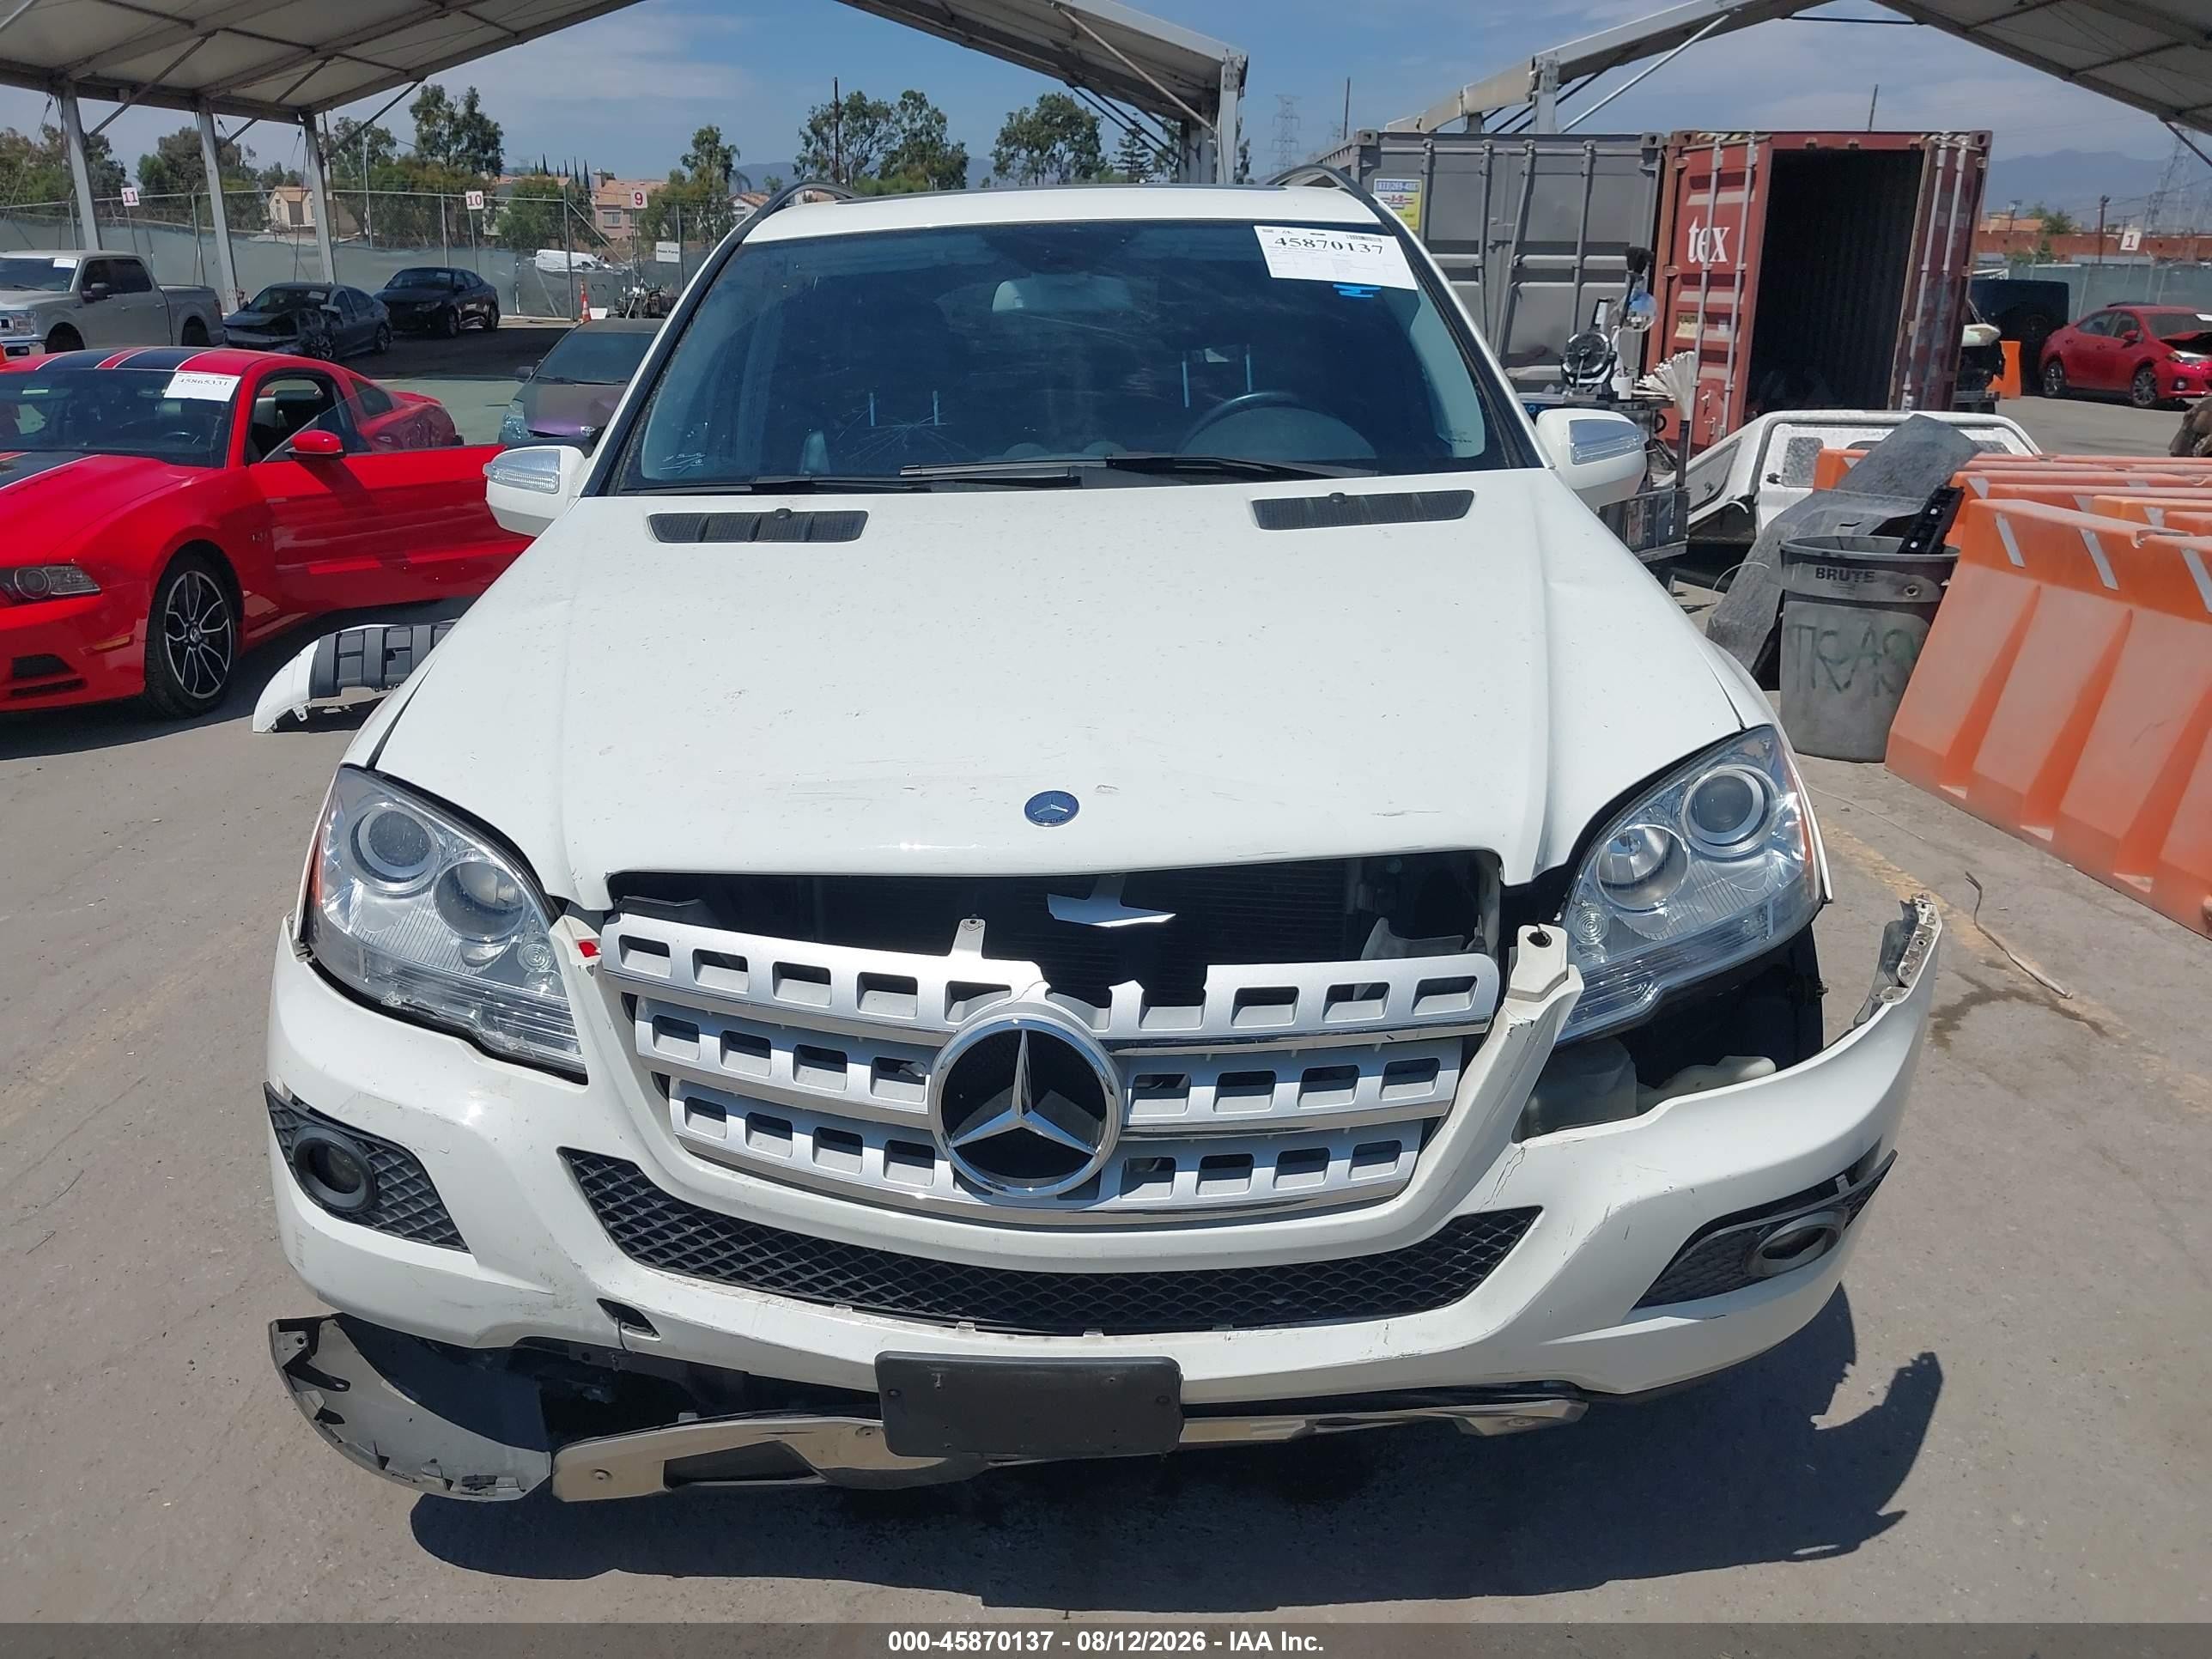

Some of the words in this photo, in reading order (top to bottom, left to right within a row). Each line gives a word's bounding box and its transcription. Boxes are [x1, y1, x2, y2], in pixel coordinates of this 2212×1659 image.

[123, 191, 137, 203] 11
[467, 194, 482, 206] 10
[634, 191, 643, 206] 9
[1274, 237, 1384, 255] 45870137
[1687, 216, 1730, 263] tex
[2125, 234, 2134, 248] 1
[1815, 568, 1878, 583] BRUTE
[1786, 623, 1916, 697] TRAS
